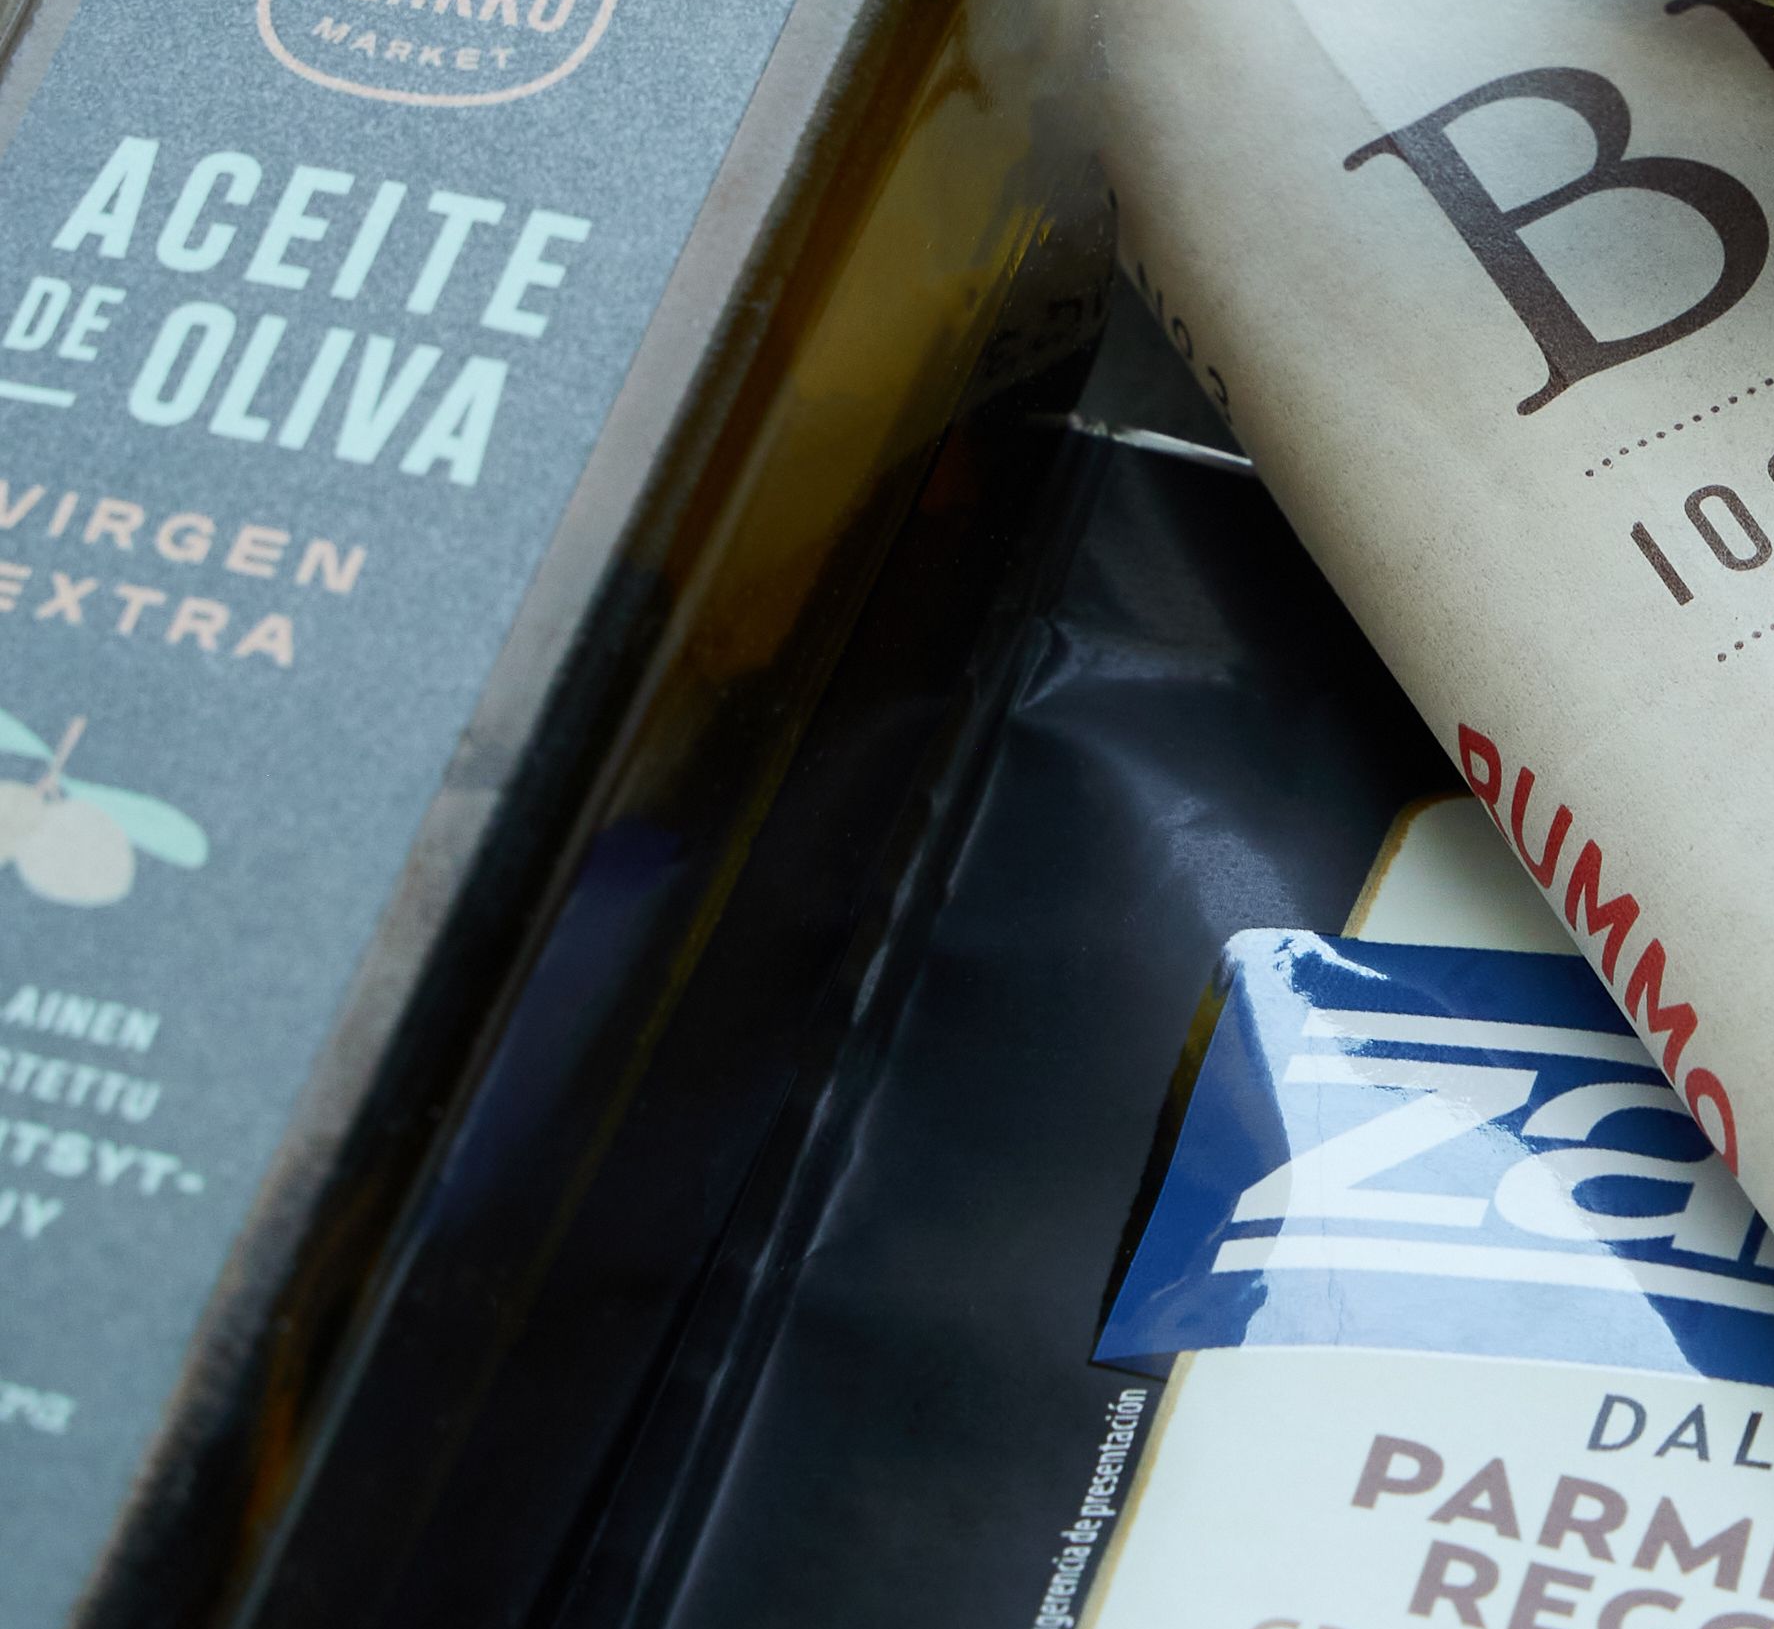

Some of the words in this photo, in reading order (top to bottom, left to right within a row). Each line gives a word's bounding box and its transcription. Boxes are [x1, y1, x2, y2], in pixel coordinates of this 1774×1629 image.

[312, 16, 514, 70] MARKET
[53, 135, 592, 338] ACEITE
[5, 276, 125, 361] DE
[128, 301, 510, 486] OLIVA
[0, 477, 367, 596] VIRGEN
[0, 562, 294, 668] EXTRA
[1458, 722, 1738, 1178] RUMMO
[1080, 1388, 1148, 1517] presentación
[1586, 1394, 1772, 1470] DAL
[1060, 1518, 1103, 1543] de
